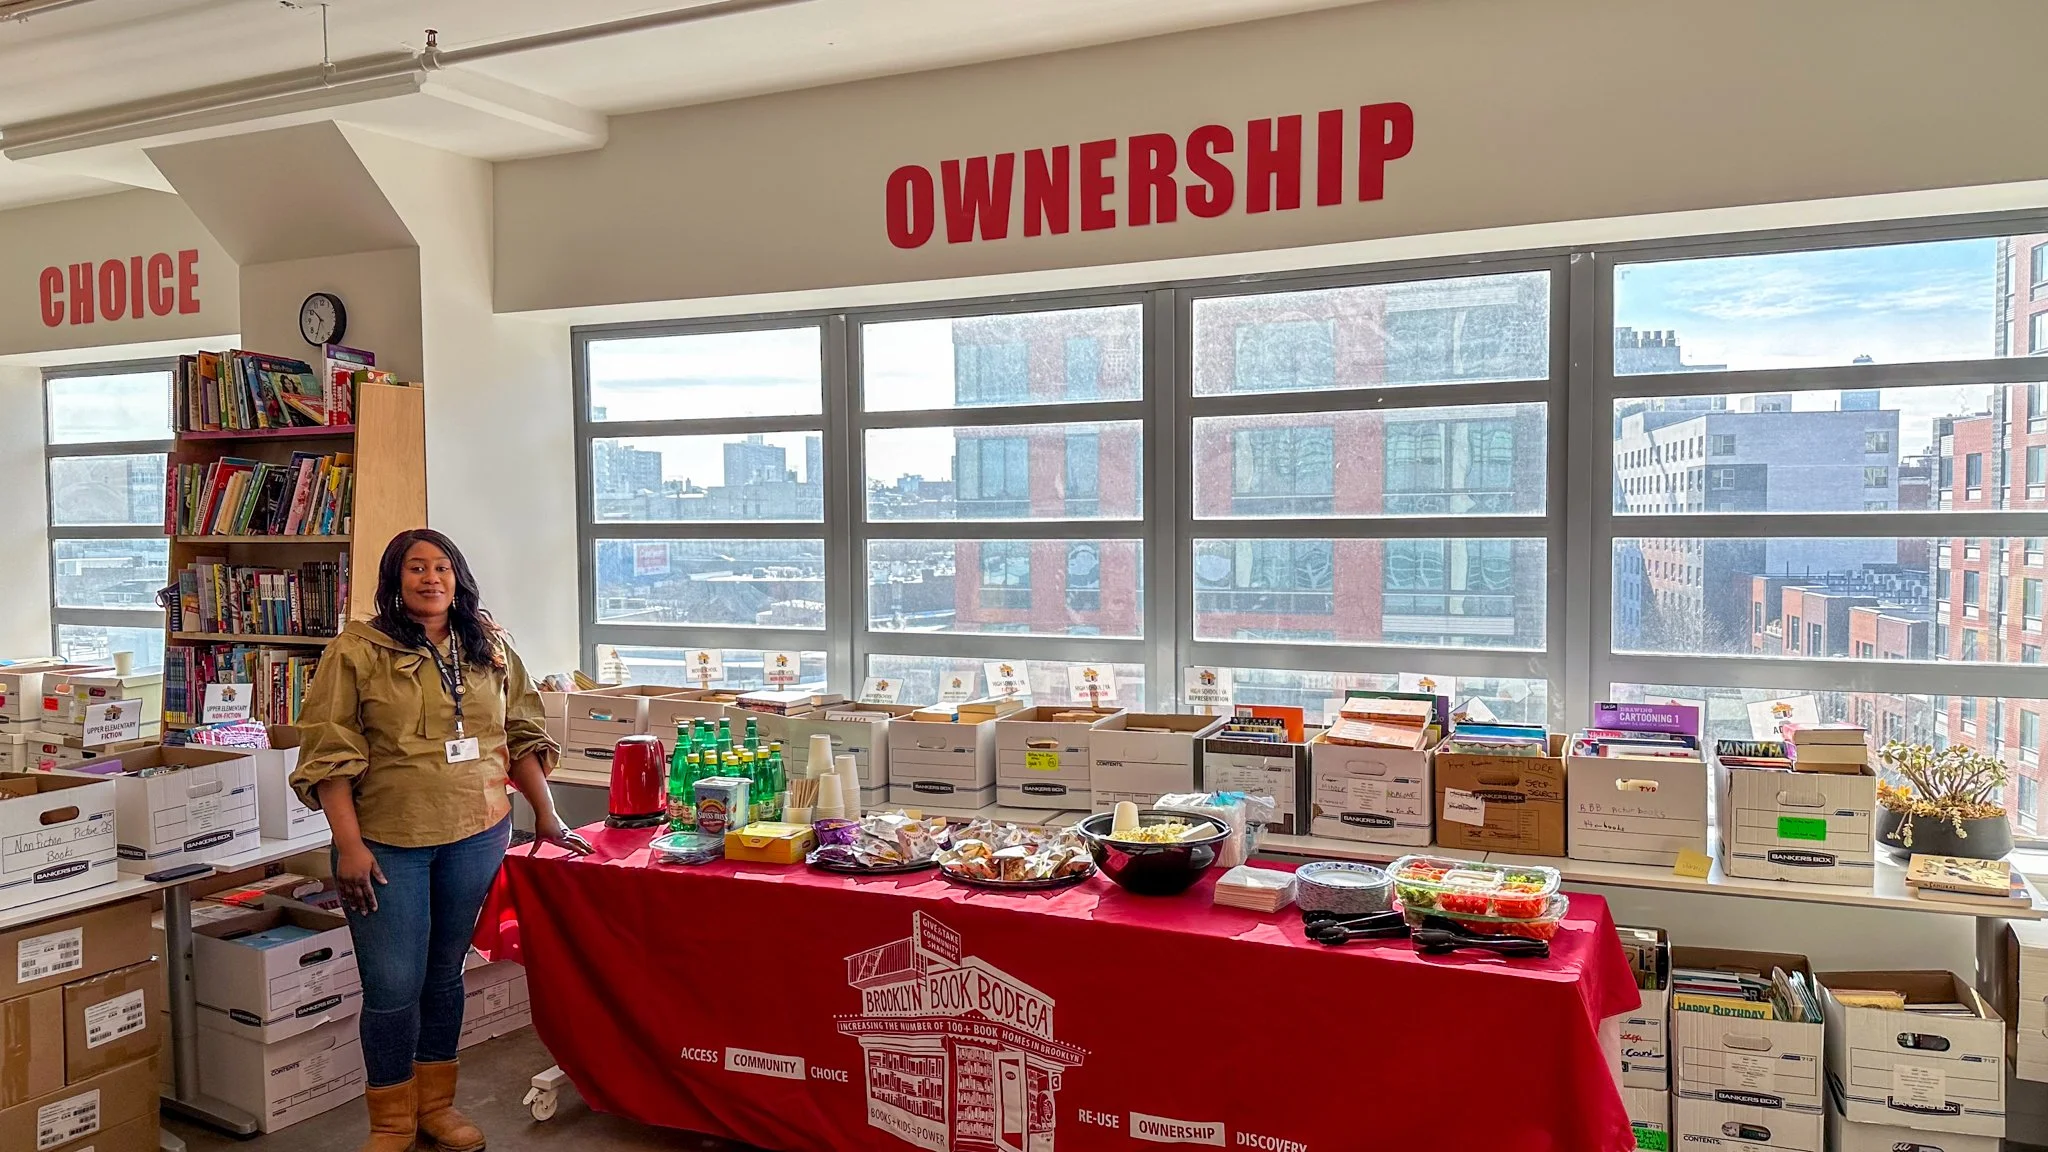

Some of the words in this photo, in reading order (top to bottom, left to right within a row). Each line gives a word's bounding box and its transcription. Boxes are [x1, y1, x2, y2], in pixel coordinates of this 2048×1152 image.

[886, 102, 1413, 249] OWNERSHIP
[40, 249, 200, 327] CHOICE
[1619, 712, 1672, 723] CARTOONING
[1674, 714, 1679, 724] 1
[86, 723, 104, 735] UPPER
[104, 721, 136, 733] ELEMENTARY
[101, 731, 122, 741] FICTION
[1718, 740, 1764, 757] VANITY
[1766, 742, 1784, 758] FA
[1344, 815, 1376, 824] BANKERS
[1376, 818, 1391, 826] BOX
[186, 836, 216, 850] BANKERS
[217, 831, 232, 843] BOX
[1771, 853, 1812, 862] BANKERS
[1812, 856, 1832, 864] BOX
[37, 865, 66, 880] BANKERS
[67, 861, 87, 873] BOX
[923, 929, 959, 954] COMMUNITY
[927, 940, 956, 961] SHARING
[297, 1001, 326, 1015] BANKERS
[326, 996, 340, 1006] BOX
[866, 983, 922, 1012] BROOKLYN
[930, 970, 972, 1010] BOOK
[977, 974, 1048, 1035] BODEGA
[1678, 1001, 1710, 1013] HAPPY
[1712, 1004, 1765, 1019] BIRTHDAY
[839, 1021, 883, 1031] INCREASING
[884, 1021, 898, 1031] THE
[899, 1021, 932, 1031] NUMBER
[934, 1021, 943, 1031] OF
[948, 1021, 970, 1034] 100+
[973, 1024, 998, 1037] BOOK
[1002, 1030, 1030, 1047] HOMES
[1031, 1039, 1040, 1050] IN
[1040, 1042, 1080, 1063] BROOKLYN
[271, 1062, 300, 1076] CONTENTS
[681, 1047, 718, 1063] ACCESS
[733, 1053, 797, 1074] COMMUNITY
[810, 1065, 849, 1083] CHOICE
[1718, 1092, 1759, 1104] BANKERS
[1759, 1097, 1778, 1106] BOX
[1079, 1108, 1119, 1129] RE-USE
[1139, 1120, 1215, 1140] OWNERSHIP
[1237, 1131, 1308, 1152] DISCOVERY
[1683, 1134, 1721, 1145] CONTENTS
